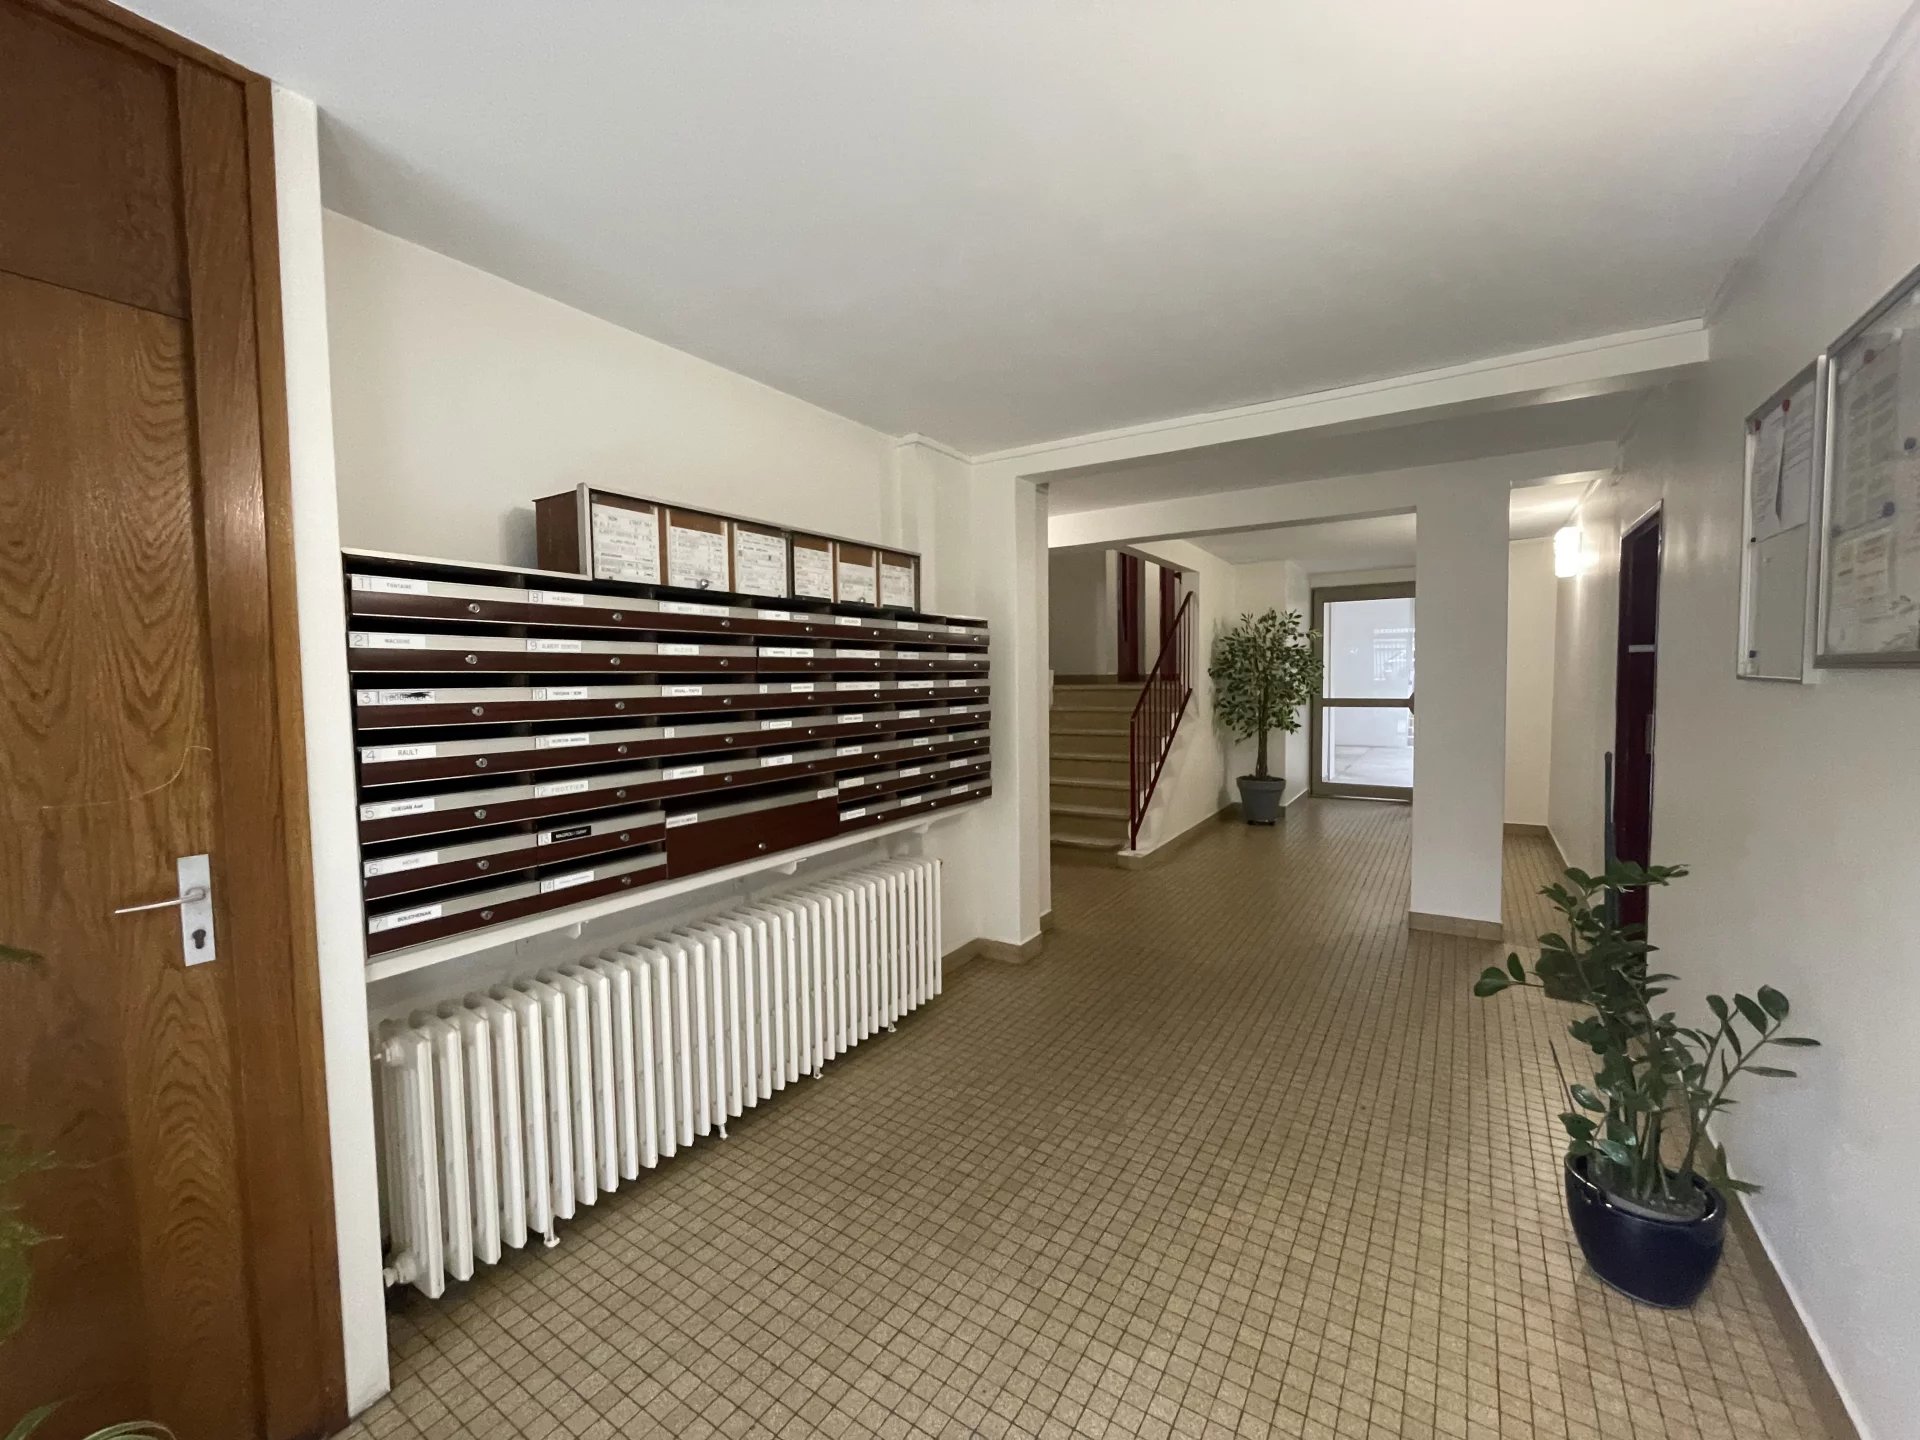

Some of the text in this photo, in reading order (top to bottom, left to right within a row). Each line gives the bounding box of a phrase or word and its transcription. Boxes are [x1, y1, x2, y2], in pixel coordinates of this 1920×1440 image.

[532, 592, 539, 603] 8
[354, 634, 364, 646] 2
[530, 640, 538, 651] 9
[360, 692, 371, 704] 3
[365, 748, 418, 761] 4 RAULT
[364, 808, 375, 819] 5
[368, 863, 378, 875] 6
